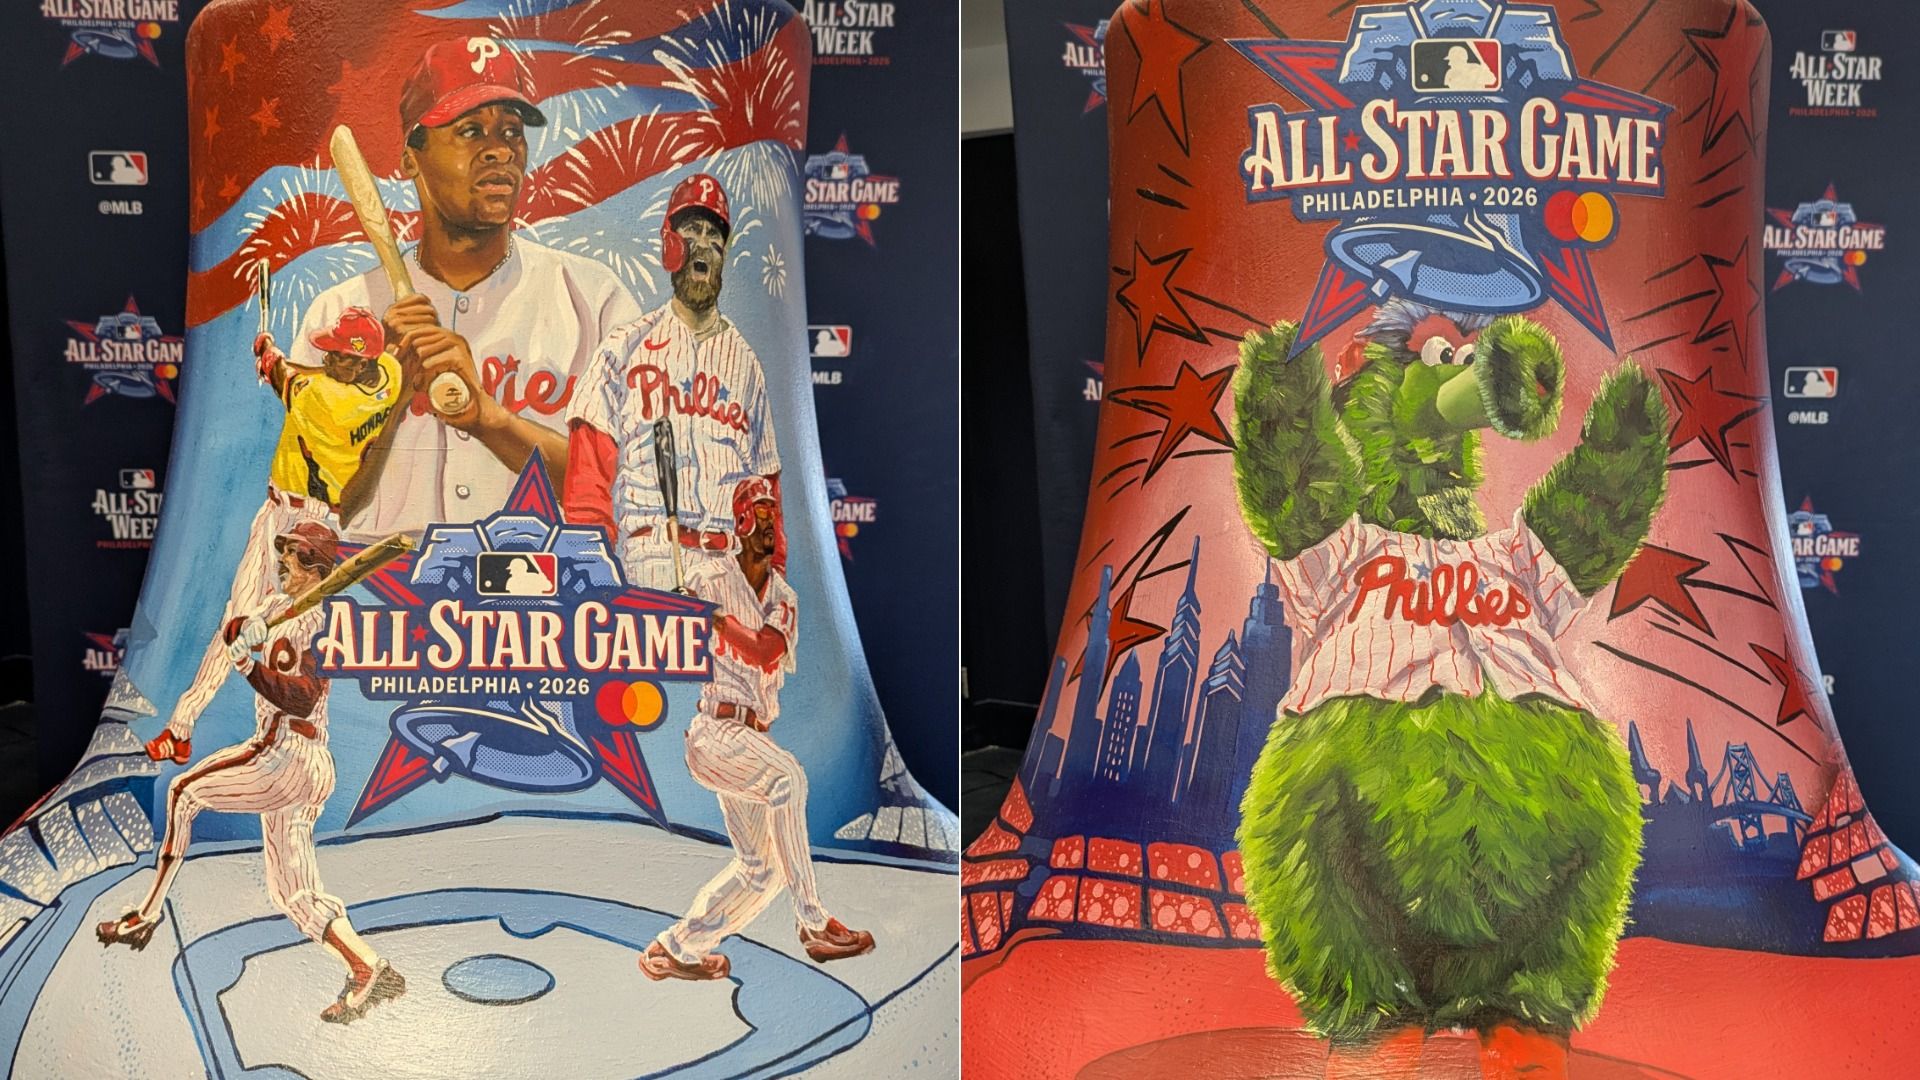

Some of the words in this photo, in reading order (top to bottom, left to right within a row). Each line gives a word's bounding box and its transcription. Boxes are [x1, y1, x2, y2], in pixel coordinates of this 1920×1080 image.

[40, 0, 78, 17] ALL
[79, 0, 126, 19] STAR
[128, 0, 179, 21] GAME
[801, 0, 840, 27] ALL
[842, 0, 895, 28] STAR
[811, 27, 874, 55] WEEK
[467, 36, 500, 74] P
[1062, 42, 1099, 68] ALL
[1789, 51, 1830, 80] ALL
[1832, 52, 1882, 80] STAR
[1802, 79, 1863, 107] WEEK
[1244, 111, 1354, 193] ALL
[1360, 98, 1514, 184] STAR
[1520, 96, 1662, 189] GAME
[805, 178, 850, 203] STAR
[850, 179, 900, 203] GAME
[1302, 187, 1464, 214] PHILADELPHIA
[1483, 187, 1538, 206] 2026
[98, 200, 144, 215] @MLB
[1762, 225, 1793, 249] ALL
[1794, 225, 1838, 249] STAR
[1838, 226, 1886, 249] GAME
[64, 338, 100, 362] ALL
[101, 339, 146, 362] STAR
[146, 339, 184, 362] GAM
[811, 370, 843, 385] MLB
[1787, 411, 1829, 425] @MLB
[91, 489, 133, 515] ALL
[831, 499, 877, 522] GAME
[106, 514, 159, 540] WEE
[1815, 534, 1860, 557] GAME
[1348, 555, 1531, 627] Phillies
[316, 601, 420, 671] ALL
[427, 598, 568, 672] STAR
[574, 601, 710, 675] GAME
[82, 648, 118, 670] ALL
[370, 676, 521, 695] PHILADELPHIA
[539, 677, 590, 695] 2026
